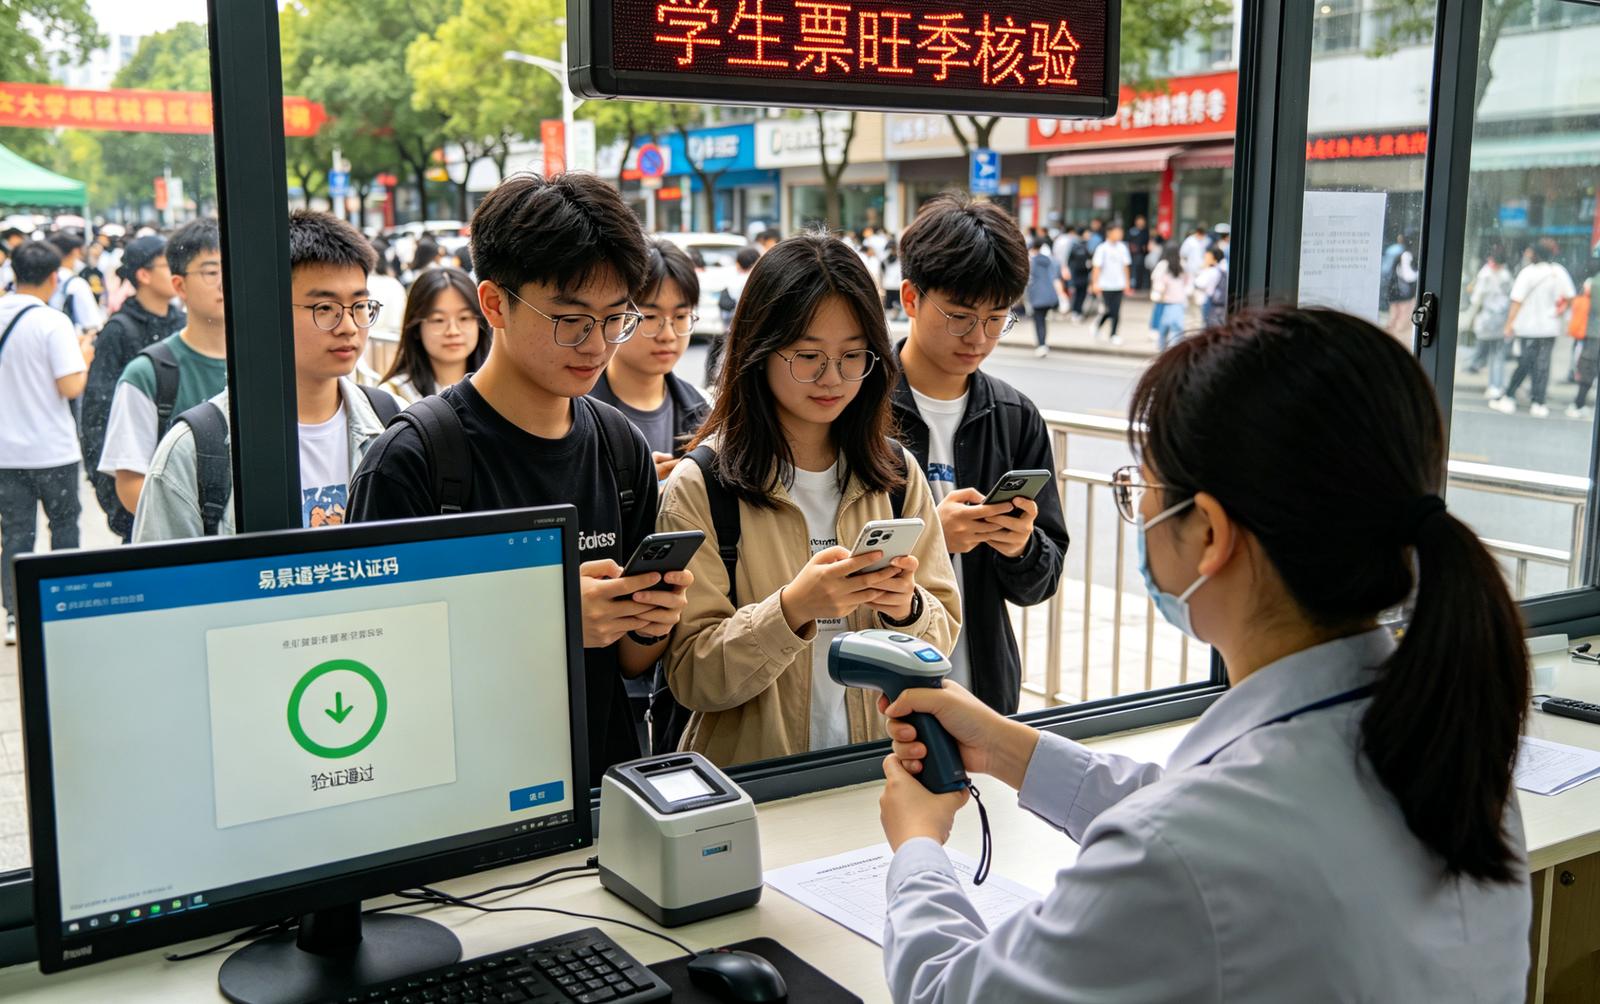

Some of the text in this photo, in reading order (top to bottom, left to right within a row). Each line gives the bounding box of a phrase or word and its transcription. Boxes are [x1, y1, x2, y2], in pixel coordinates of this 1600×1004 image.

[655, 0, 1081, 87] 学生票旺季核验
[258, 556, 399, 590] 易景通学生认证码
[311, 764, 374, 791] 验证通过
